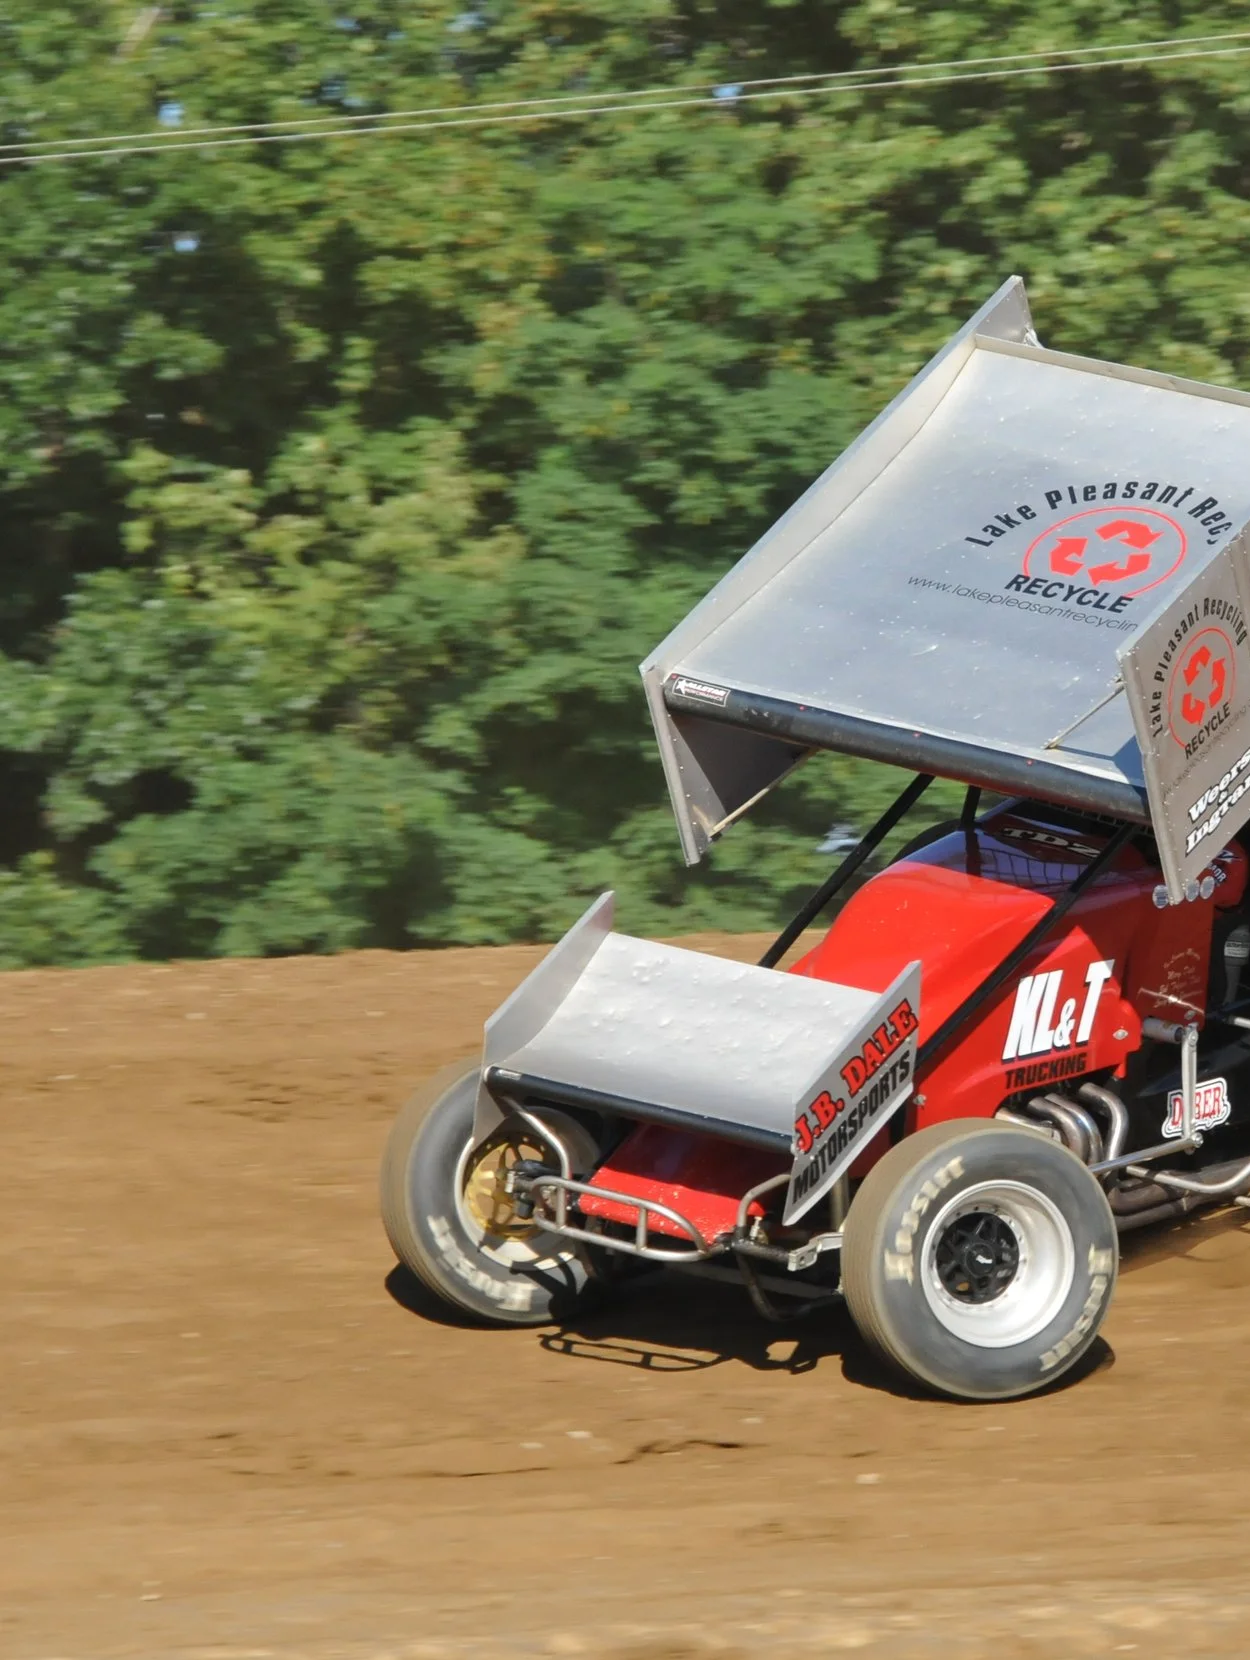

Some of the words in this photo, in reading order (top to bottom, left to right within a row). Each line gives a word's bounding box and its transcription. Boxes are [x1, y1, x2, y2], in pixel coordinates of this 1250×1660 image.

[964, 504, 1036, 548] Lake
[1044, 481, 1195, 510] Pleasant
[1004, 573, 1134, 614] RECYCLE
[1203, 597, 1248, 646] Recycling
[1154, 603, 1200, 683] Pleasant
[1149, 691, 1163, 738] Lake
[1184, 702, 1231, 760] RECYCLE
[795, 1090, 845, 1155] J.B.
[840, 998, 919, 1098] DALE
[1005, 1052, 1088, 1090] TRUCKING
[792, 1050, 911, 1205] MOTORSPORTS
